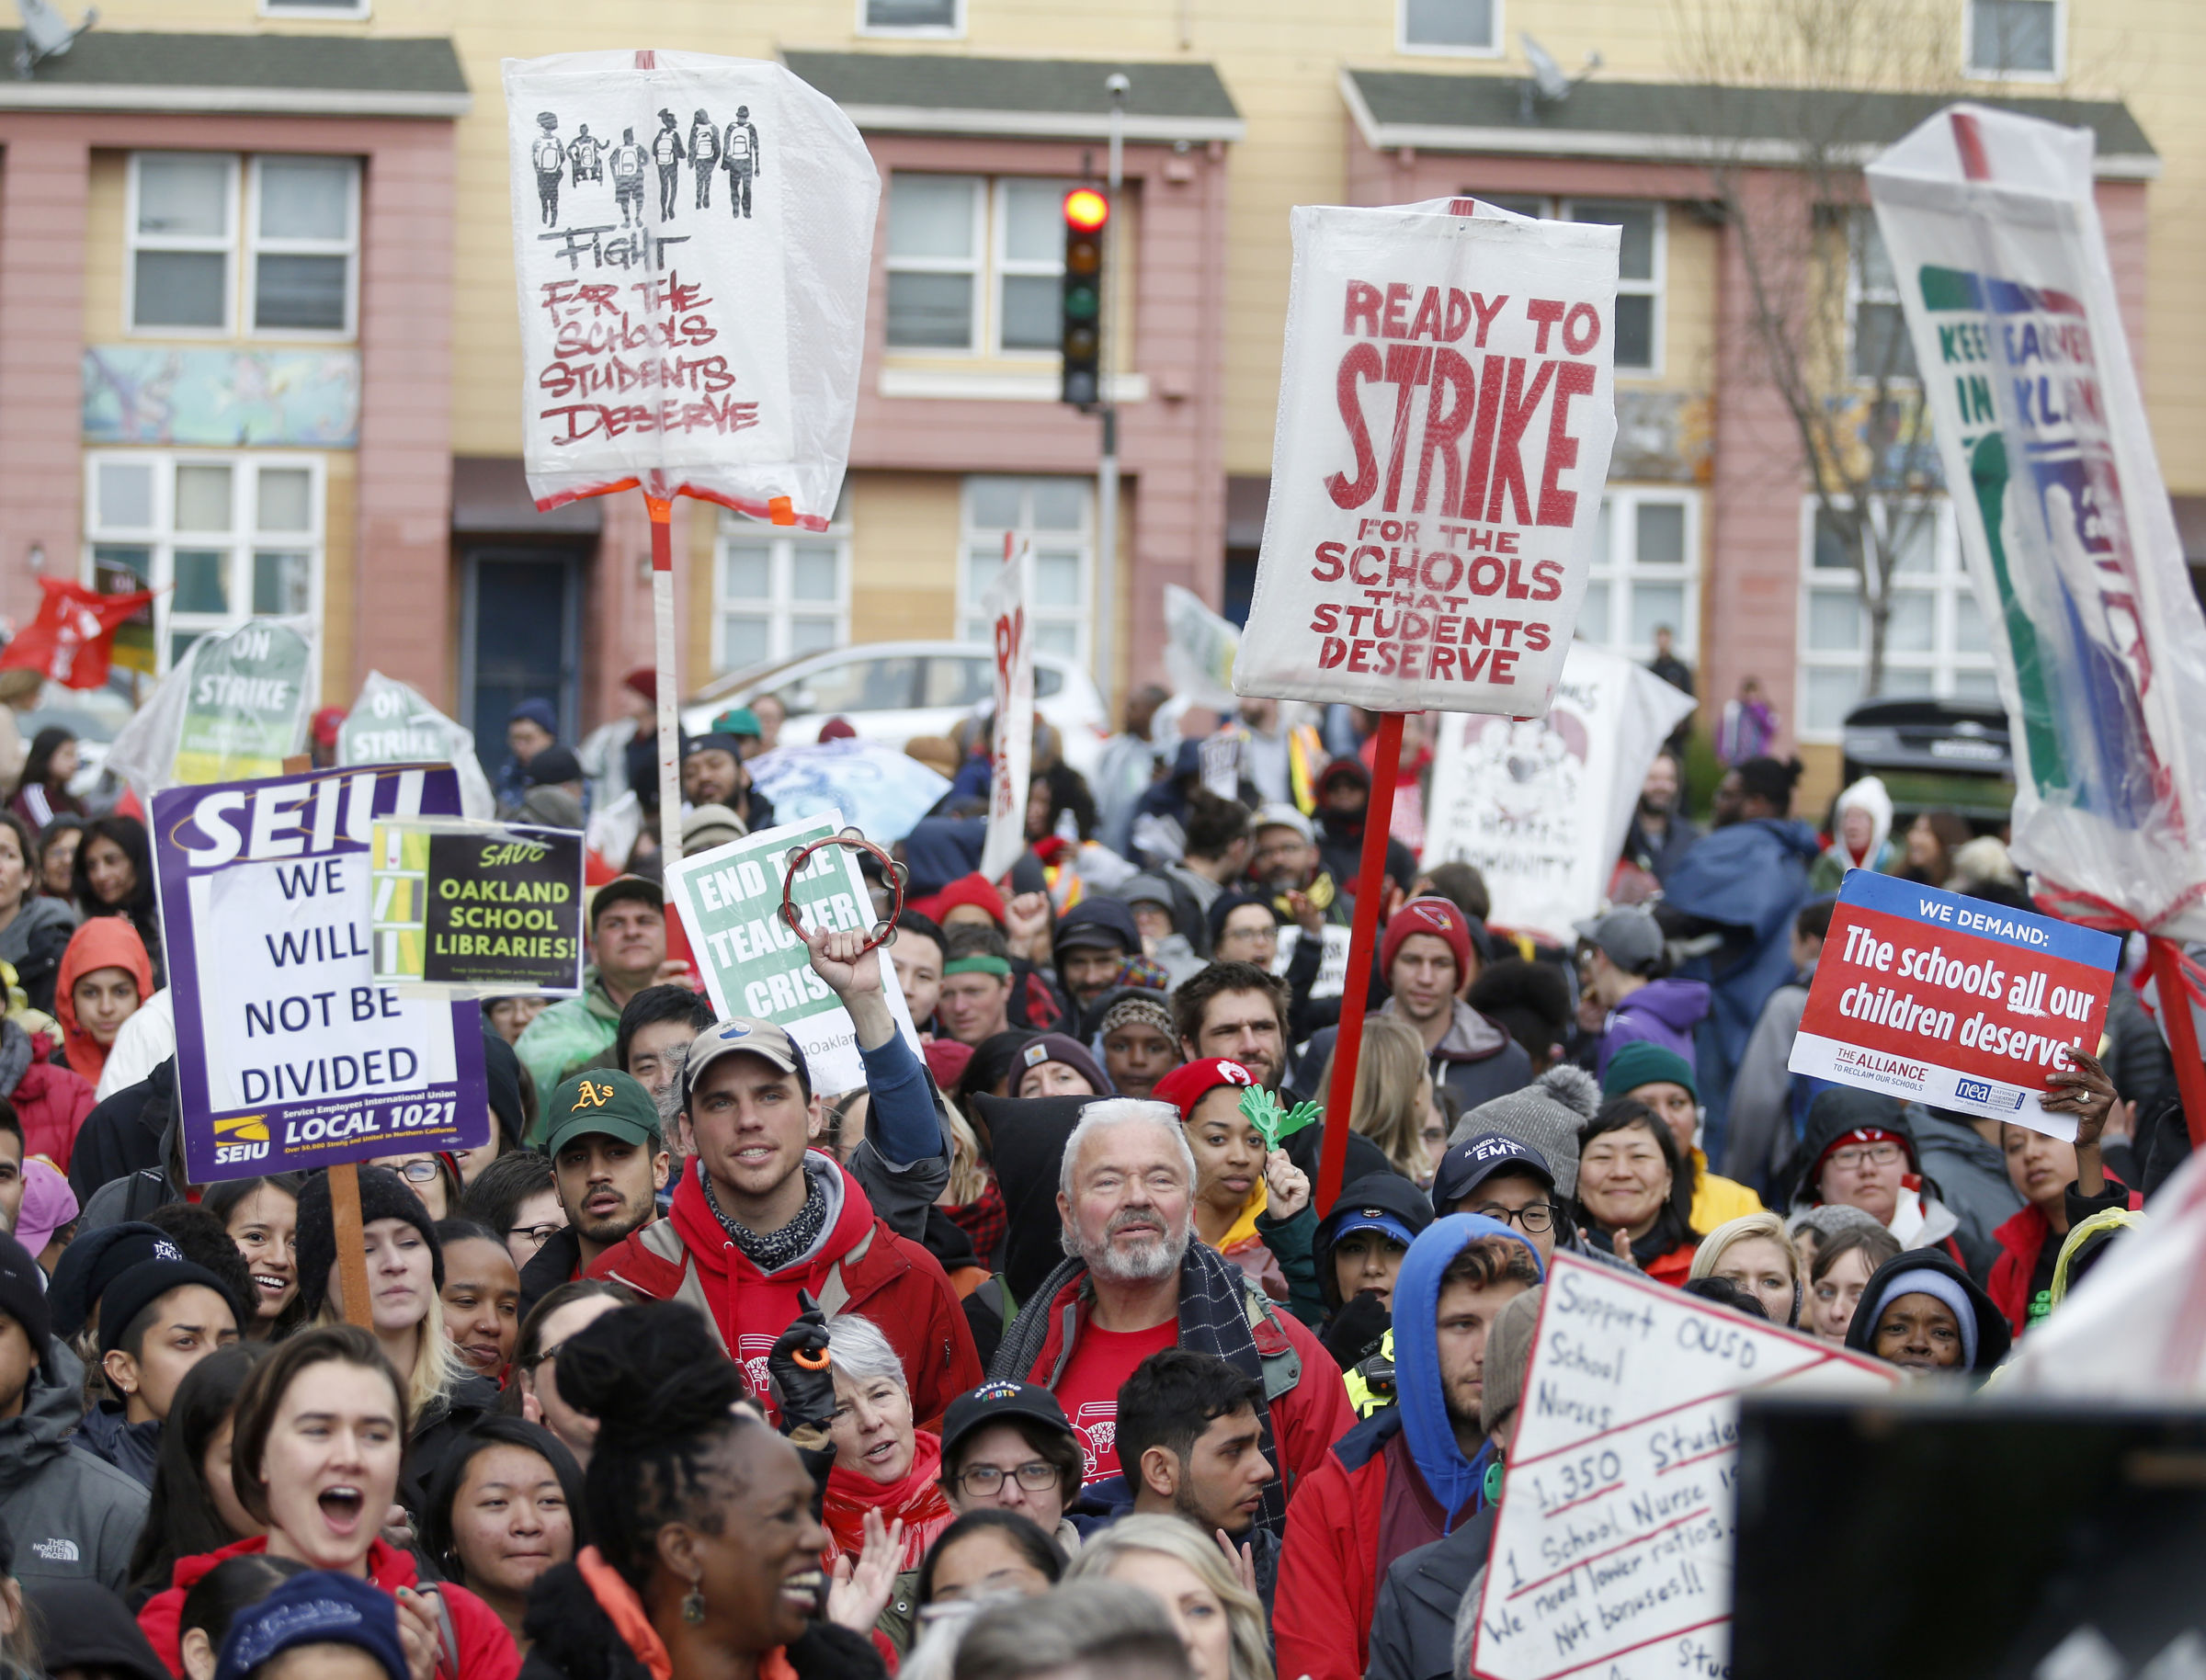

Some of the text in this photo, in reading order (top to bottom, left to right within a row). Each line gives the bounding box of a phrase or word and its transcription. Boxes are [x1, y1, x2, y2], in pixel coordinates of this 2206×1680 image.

[540, 269, 713, 328] FOR THE
[1342, 278, 1601, 356] READY TO
[553, 312, 718, 358] SCHOOLS
[540, 355, 736, 399] STUDENTS
[540, 393, 759, 446] DESERVE
[1322, 342, 1598, 528] STRIKE
[1357, 518, 1520, 554] FOR THE
[1311, 540, 1565, 602] SCHOOLS
[1364, 590, 1469, 614] THAT
[232, 630, 270, 662] ON
[1310, 603, 1552, 652] STUDENTS
[1318, 636, 1520, 685] DESERVE
[195, 674, 290, 711] STRIKE
[188, 769, 426, 868] SEIU
[277, 858, 346, 900] WE
[439, 878, 571, 903] OAKLAND
[696, 859, 768, 913] END
[449, 906, 559, 931] SCHOOL
[1919, 898, 2050, 948] WE DEMAND:
[265, 922, 370, 968] WILL
[435, 933, 577, 959] LIBRARIES!
[744, 963, 837, 1019] CRIS
[1842, 924, 2095, 1023] The schools all our
[244, 986, 402, 1039] NOT BE
[1838, 982, 2082, 1073] children deserve!
[242, 1047, 419, 1105] DIVIDED
[1833, 1063, 1924, 1092] TO RECLAIM OUR SCHOOLS
[1837, 1048, 1929, 1083] THE ALLIANCE
[283, 1090, 457, 1118] Service Employees International Union
[571, 1080, 614, 1113] A's
[1957, 1082, 1990, 1102] nea
[285, 1101, 457, 1144] LOCAL 1021
[363, 1134, 384, 1142] United
[214, 1141, 270, 1165] SEIU
[1463, 1137, 1527, 1159] ALAMEDA COUNTY
[1476, 1143, 1518, 1162] EMT
[1556, 1271, 1757, 1370] Support OUSD
[1548, 1331, 1626, 1386] School
[974, 1380, 1022, 1399] OAKLAND
[983, 1389, 1015, 1402] ROOTS
[1536, 1379, 1613, 1431] Nurses
[1533, 1450, 1621, 1510] 1,350
[33, 1543, 64, 1553] NORTH
[40, 1550, 64, 1560] FACE
[47, 1538, 65, 1547] THE
[1507, 1549, 1525, 1589] 1
[1541, 1505, 1623, 1568] School
[1629, 1484, 1705, 1526] Nurse
[1483, 1608, 1526, 1645] We
[1534, 1566, 1577, 1620] need
[1585, 1556, 1643, 1595] lower
[1553, 1559, 1705, 1656] Not bonuses!!
